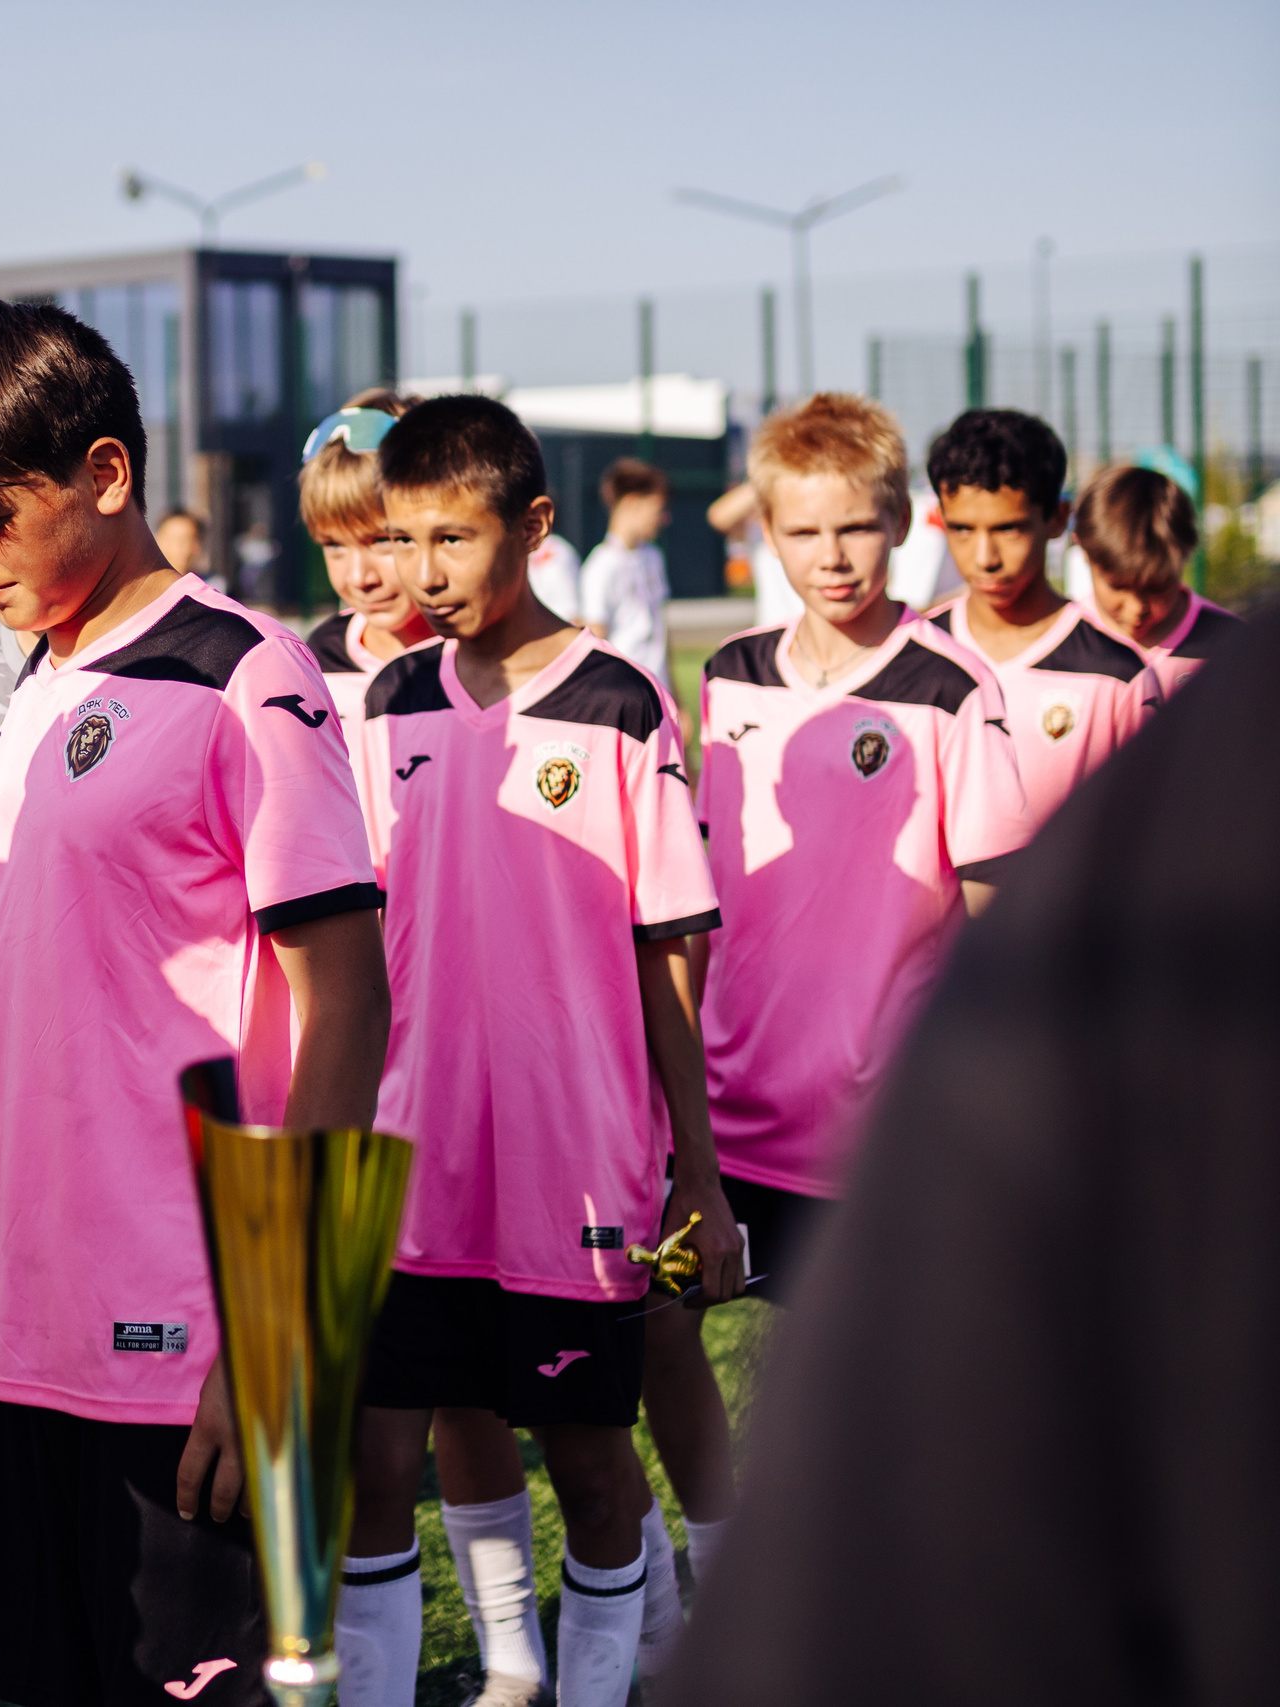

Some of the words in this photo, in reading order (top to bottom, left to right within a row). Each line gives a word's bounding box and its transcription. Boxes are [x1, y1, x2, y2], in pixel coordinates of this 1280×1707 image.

[116, 1341, 126, 1349] ALL
[128, 1341, 140, 1350] FOR
[141, 1342, 160, 1350] SPORT
